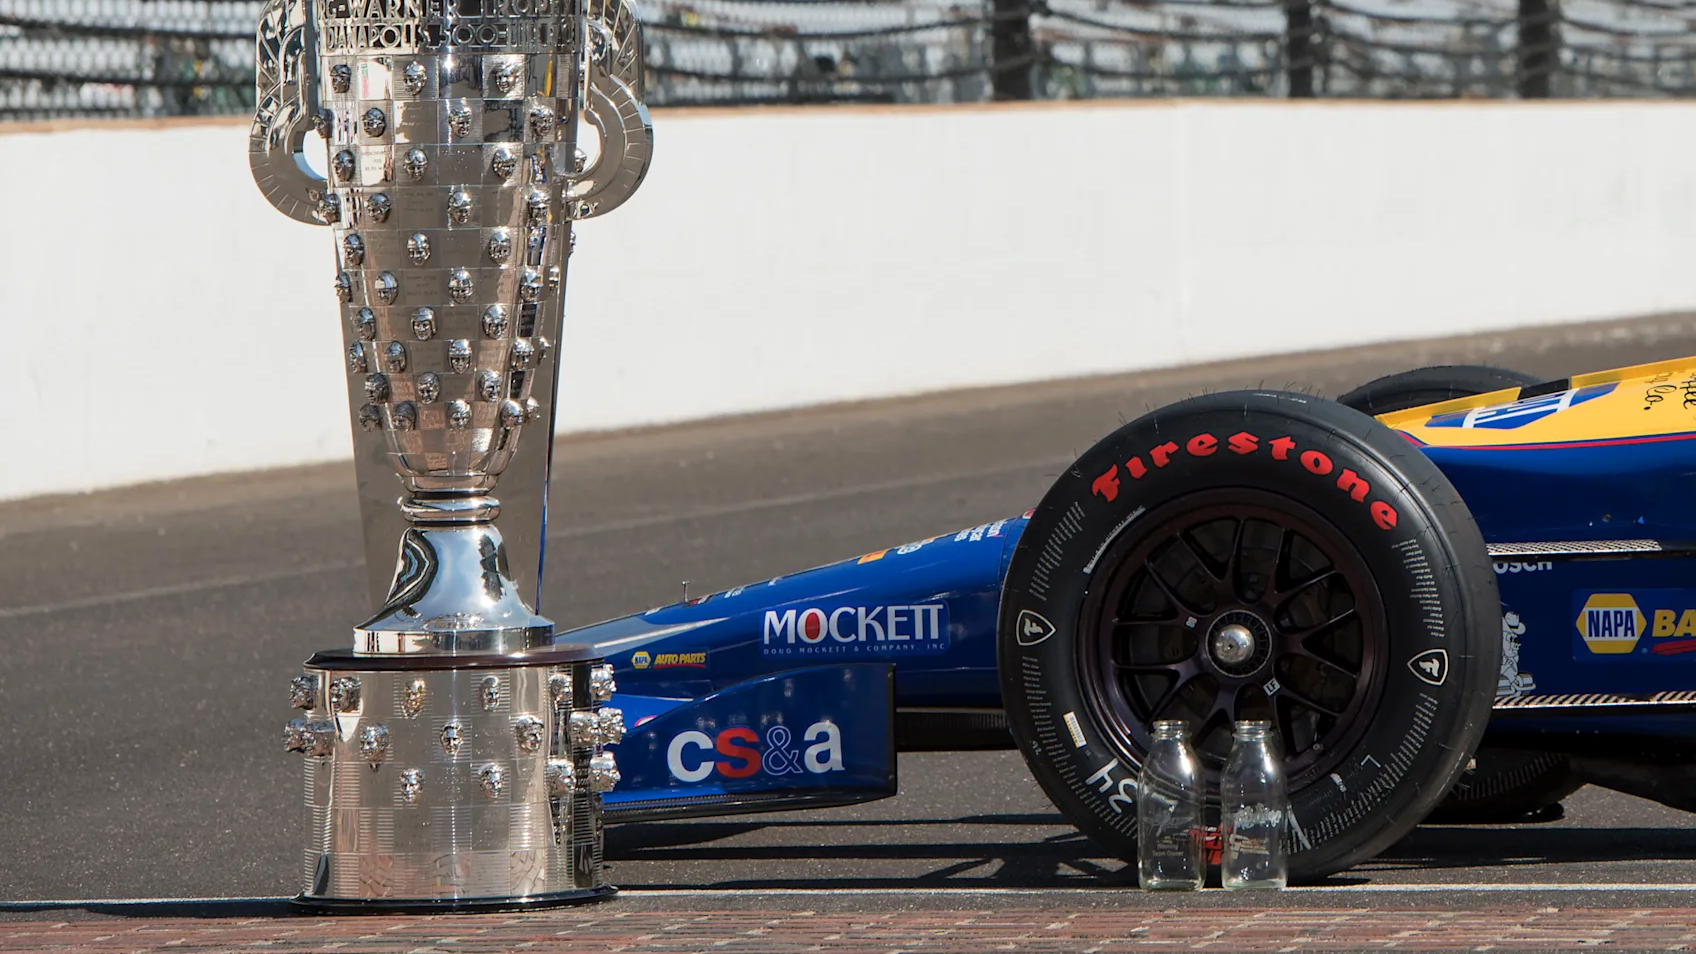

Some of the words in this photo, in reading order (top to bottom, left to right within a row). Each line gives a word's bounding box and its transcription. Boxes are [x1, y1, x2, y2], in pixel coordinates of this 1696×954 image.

[1091, 431, 1398, 530] Firestone
[763, 604, 944, 645] MOCKETT
[1588, 609, 1636, 638] NAPA
[654, 653, 678, 665] AUTO
[679, 652, 706, 665] PARTS
[800, 646, 846, 654] MOCKETT
[667, 720, 845, 783] cs&a
